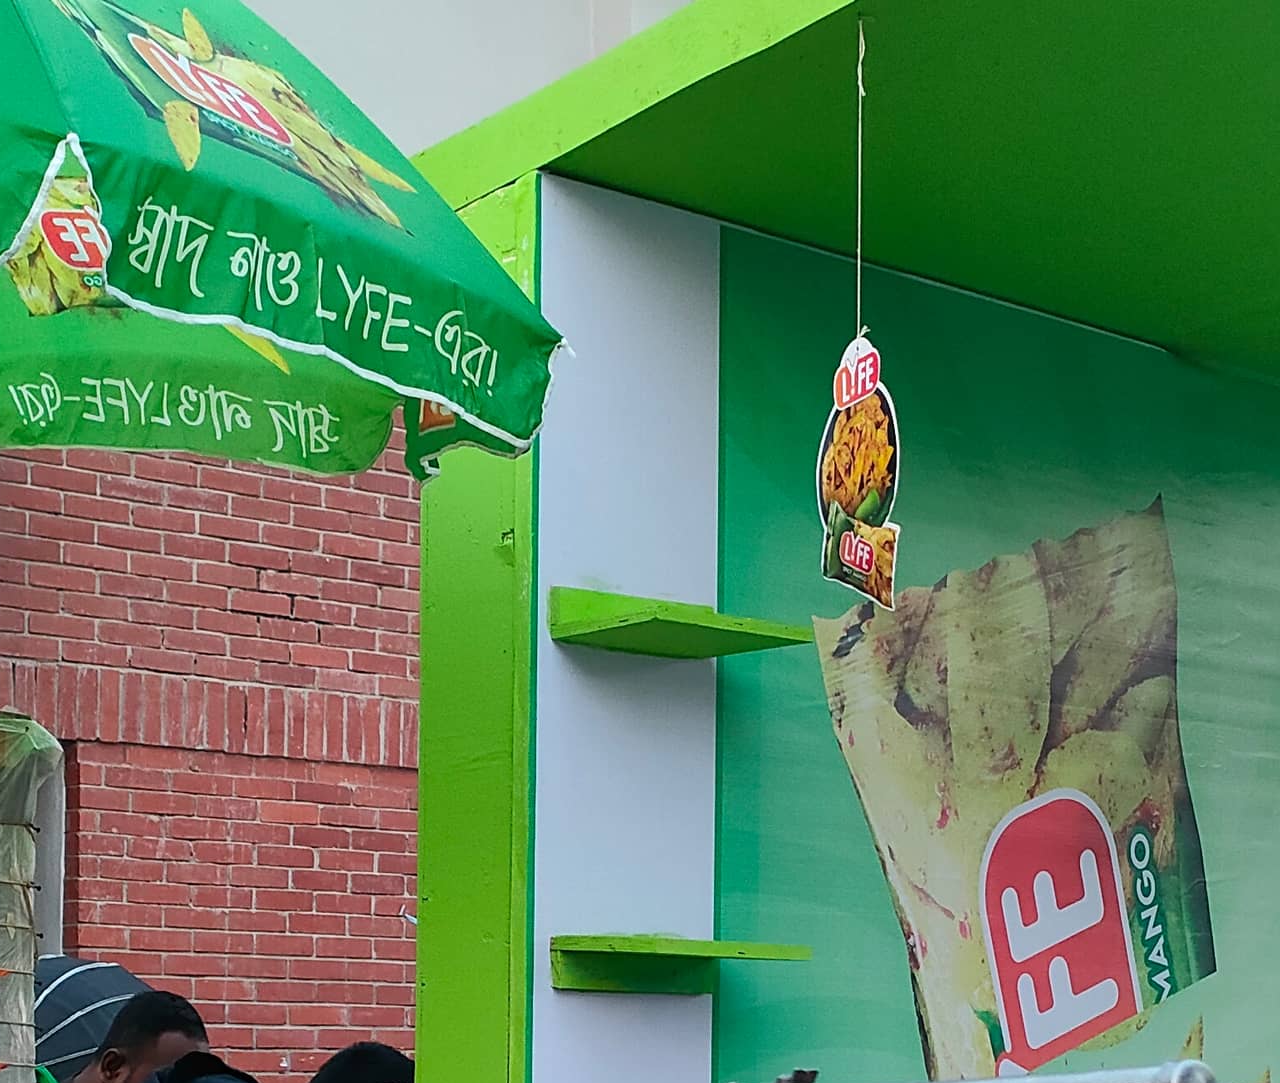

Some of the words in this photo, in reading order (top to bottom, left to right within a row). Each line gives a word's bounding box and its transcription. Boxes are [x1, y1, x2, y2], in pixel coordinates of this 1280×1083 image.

[149, 53, 278, 135] LYFE
[842, 353, 875, 403] LYFE
[844, 531, 870, 570] LYFE
[1001, 848, 1119, 1050] FE
